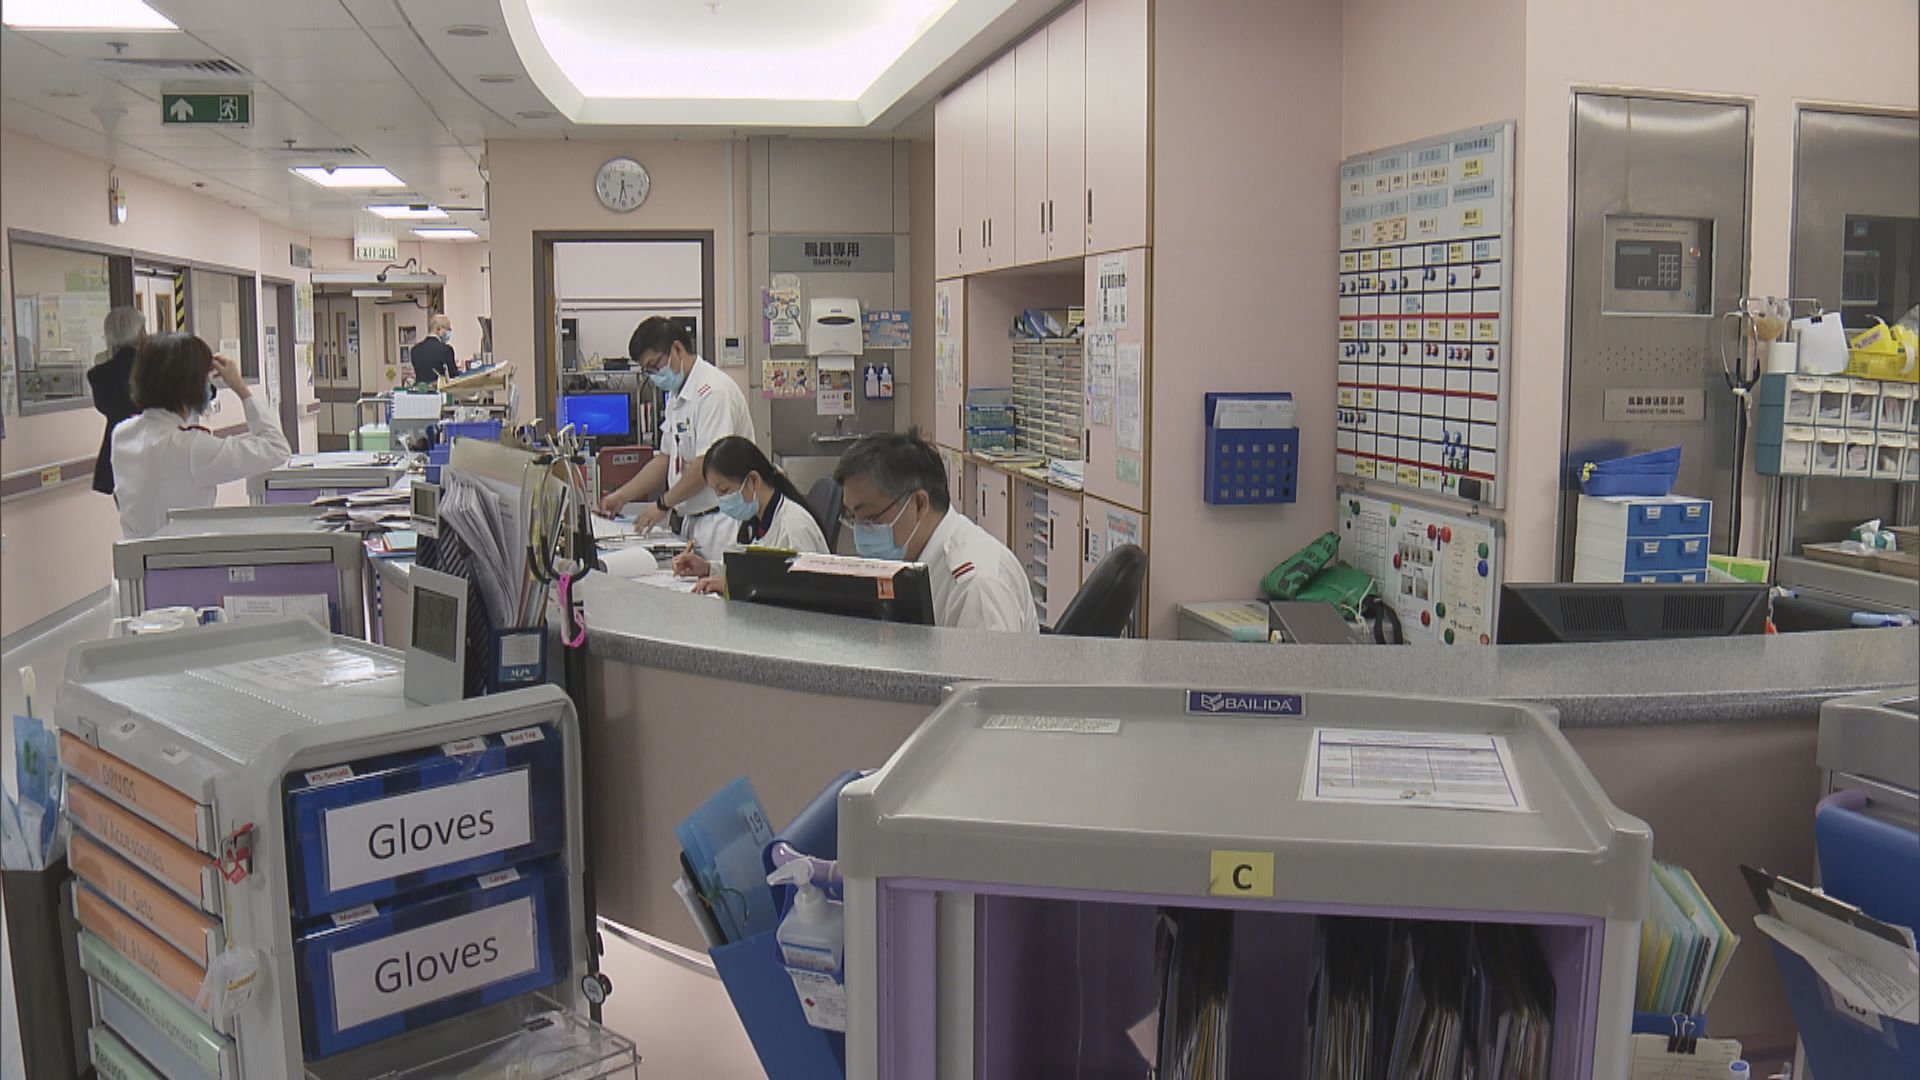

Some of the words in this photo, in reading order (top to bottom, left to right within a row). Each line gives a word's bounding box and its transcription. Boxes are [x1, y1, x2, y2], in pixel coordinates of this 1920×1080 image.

[804, 242, 859, 257] 職員專用
[813, 258, 831, 266] Staff
[833, 258, 852, 267] Only
[1225, 698, 1292, 711] BAILIDA
[453, 741, 476, 752] Small
[102, 763, 137, 801] DRUGS
[748, 812, 764, 833] 19
[368, 808, 495, 859] Gloves
[1232, 864, 1253, 890] C
[374, 936, 499, 993] Gloves
